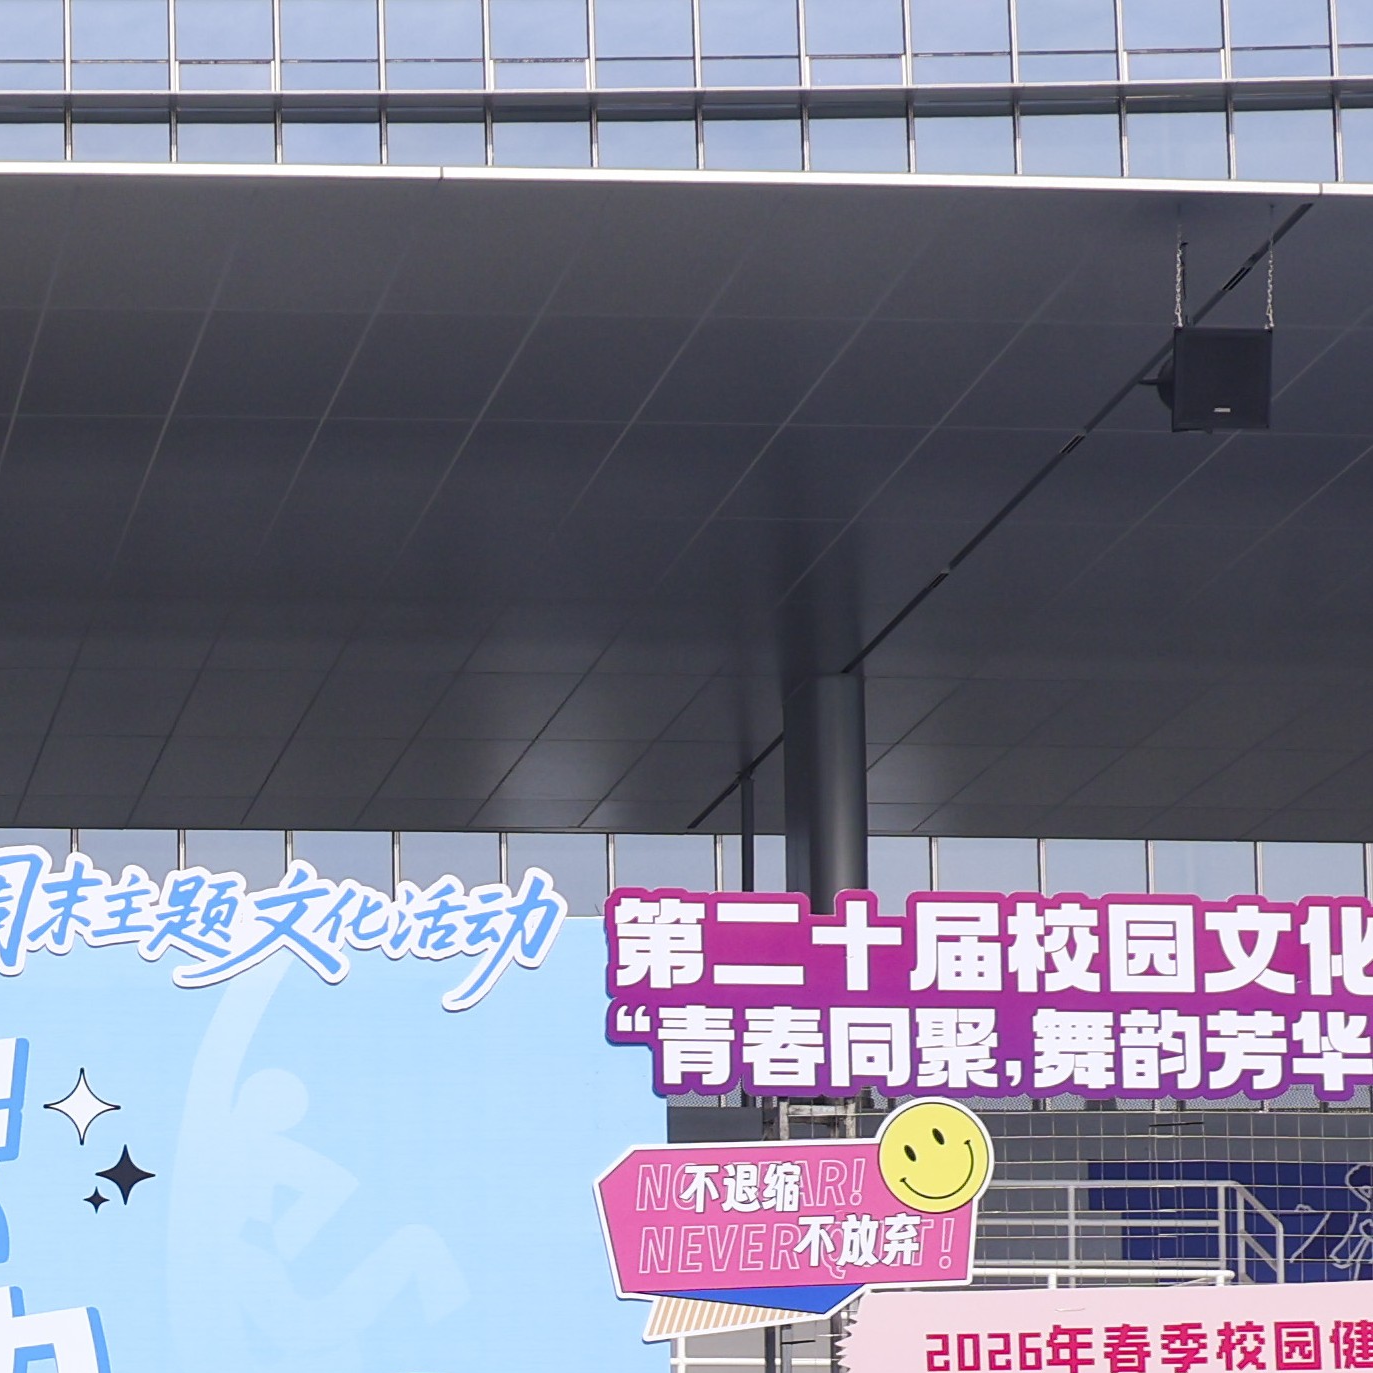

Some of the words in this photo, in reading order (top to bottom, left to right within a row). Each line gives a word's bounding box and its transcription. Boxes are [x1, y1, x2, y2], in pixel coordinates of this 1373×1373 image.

[614, 896, 1373, 996] 第二十届校园文化
[679, 1162, 801, 1213] 不退缩
[638, 1222, 802, 1275] NEVER
[794, 1212, 922, 1267] 不放弃
